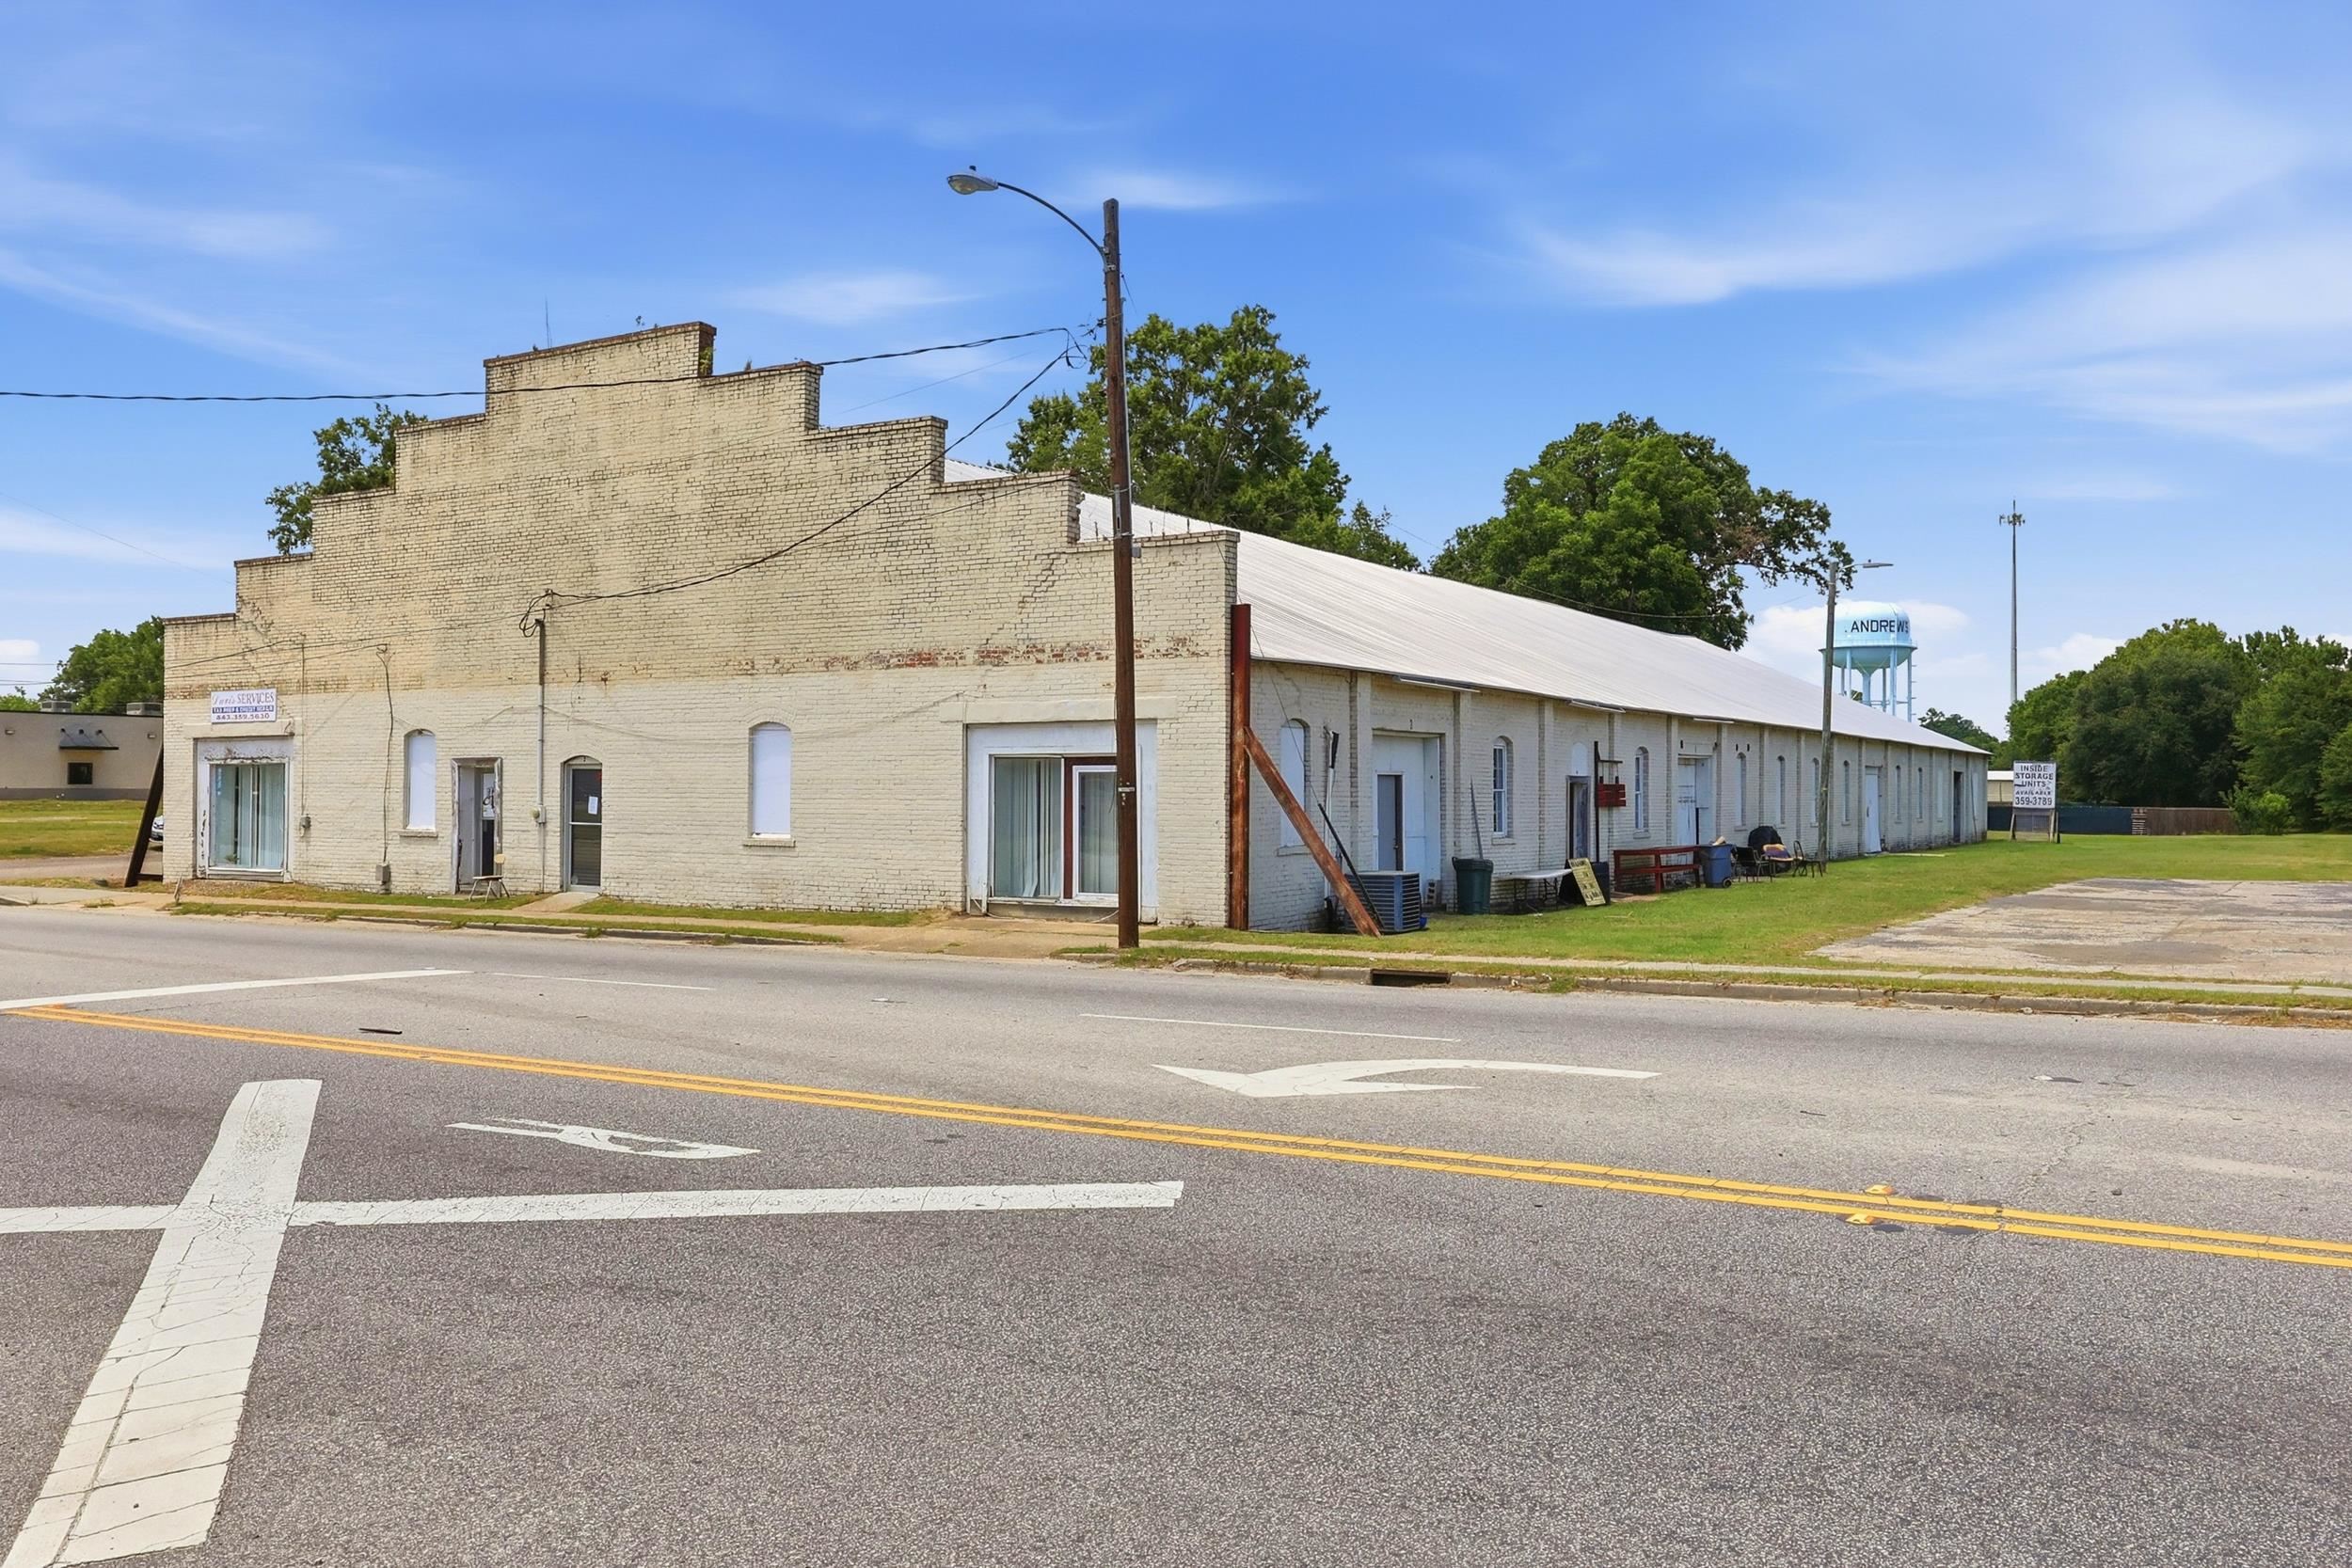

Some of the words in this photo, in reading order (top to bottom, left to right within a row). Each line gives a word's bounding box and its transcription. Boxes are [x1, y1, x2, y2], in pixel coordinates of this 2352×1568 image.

[1851, 620, 1909, 634] ANDREWS
[237, 692, 275, 705] SERVICES
[2015, 796, 2052, 806] 359-3789
